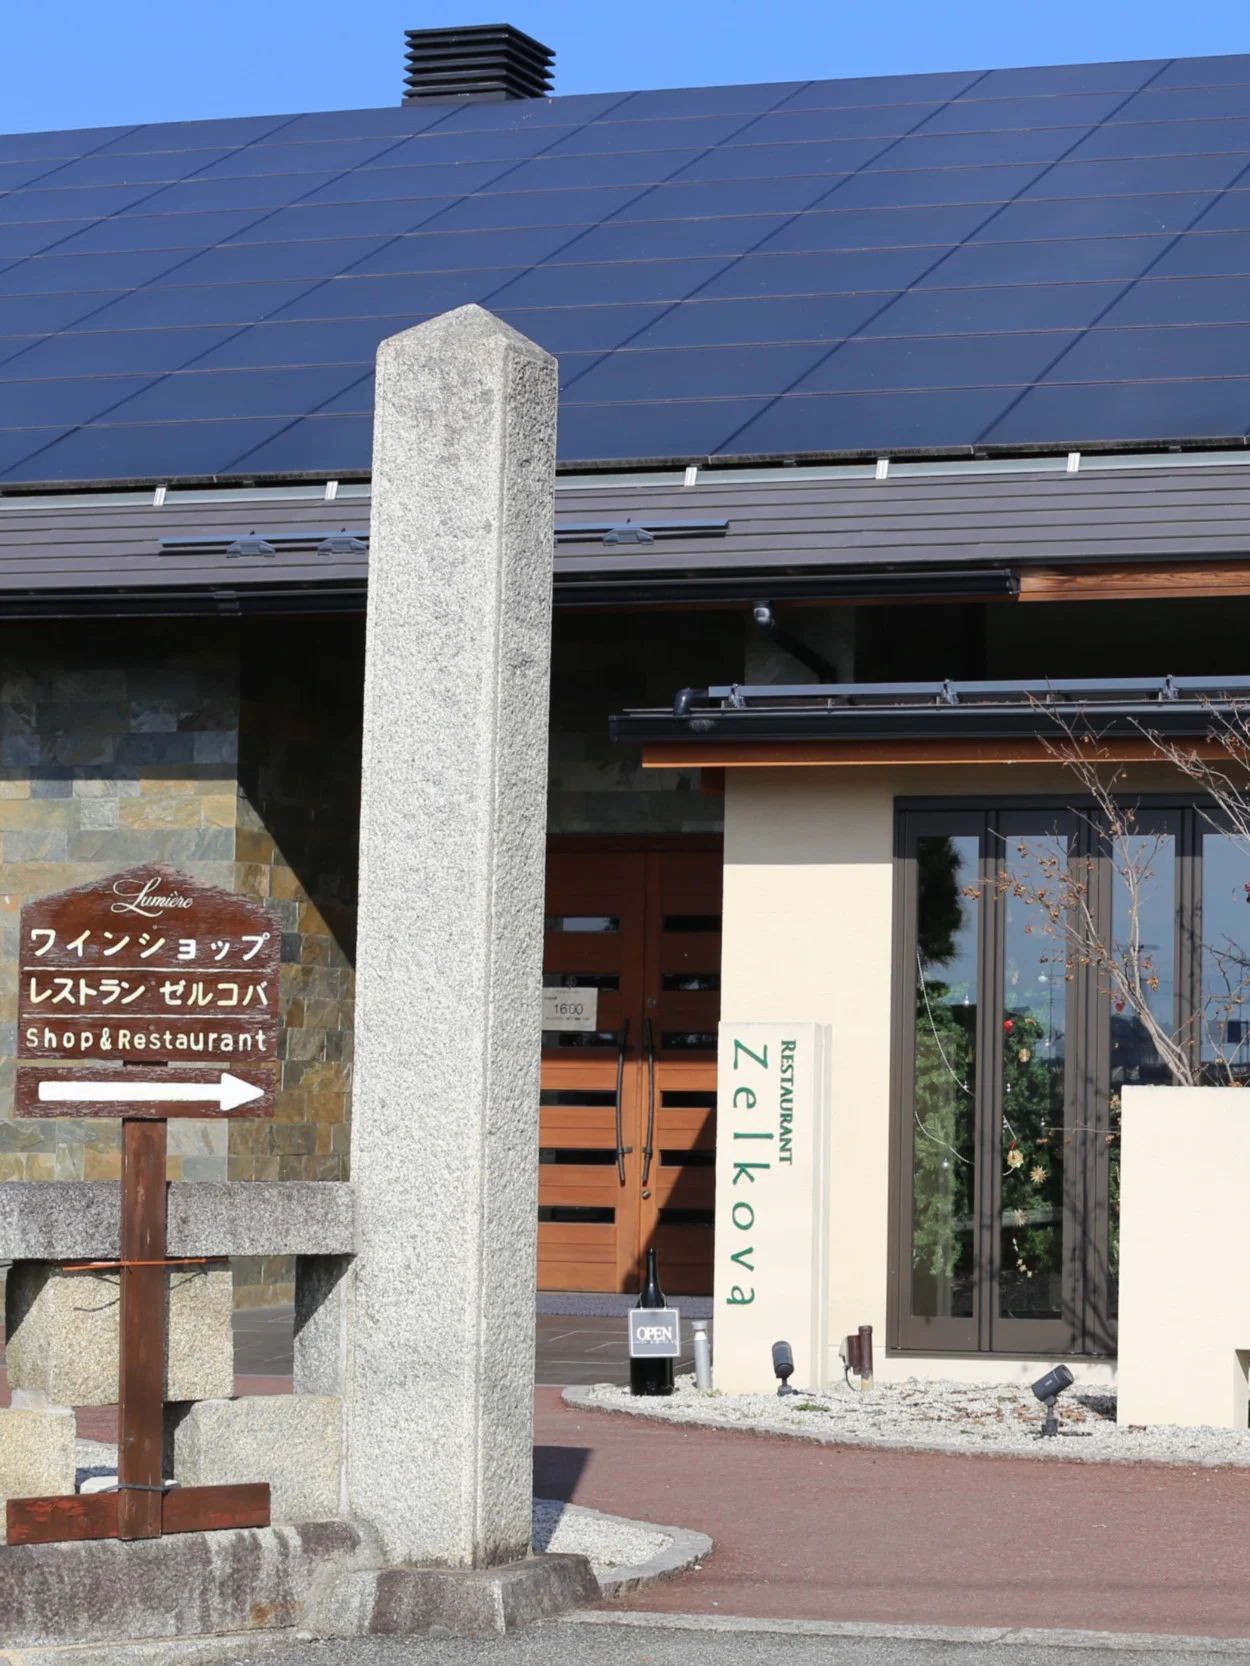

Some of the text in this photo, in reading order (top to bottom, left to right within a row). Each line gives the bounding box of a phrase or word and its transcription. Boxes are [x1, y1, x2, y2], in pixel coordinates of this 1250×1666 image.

[110, 876, 194, 918] Lumière
[30, 929, 271, 961] ワインショップ
[30, 977, 268, 1006] レストラン ゼルコバ
[779, 1039, 797, 1165] RESTAURANT
[726, 1039, 774, 1306] Zelkova
[637, 1326, 672, 1340] OPEN
